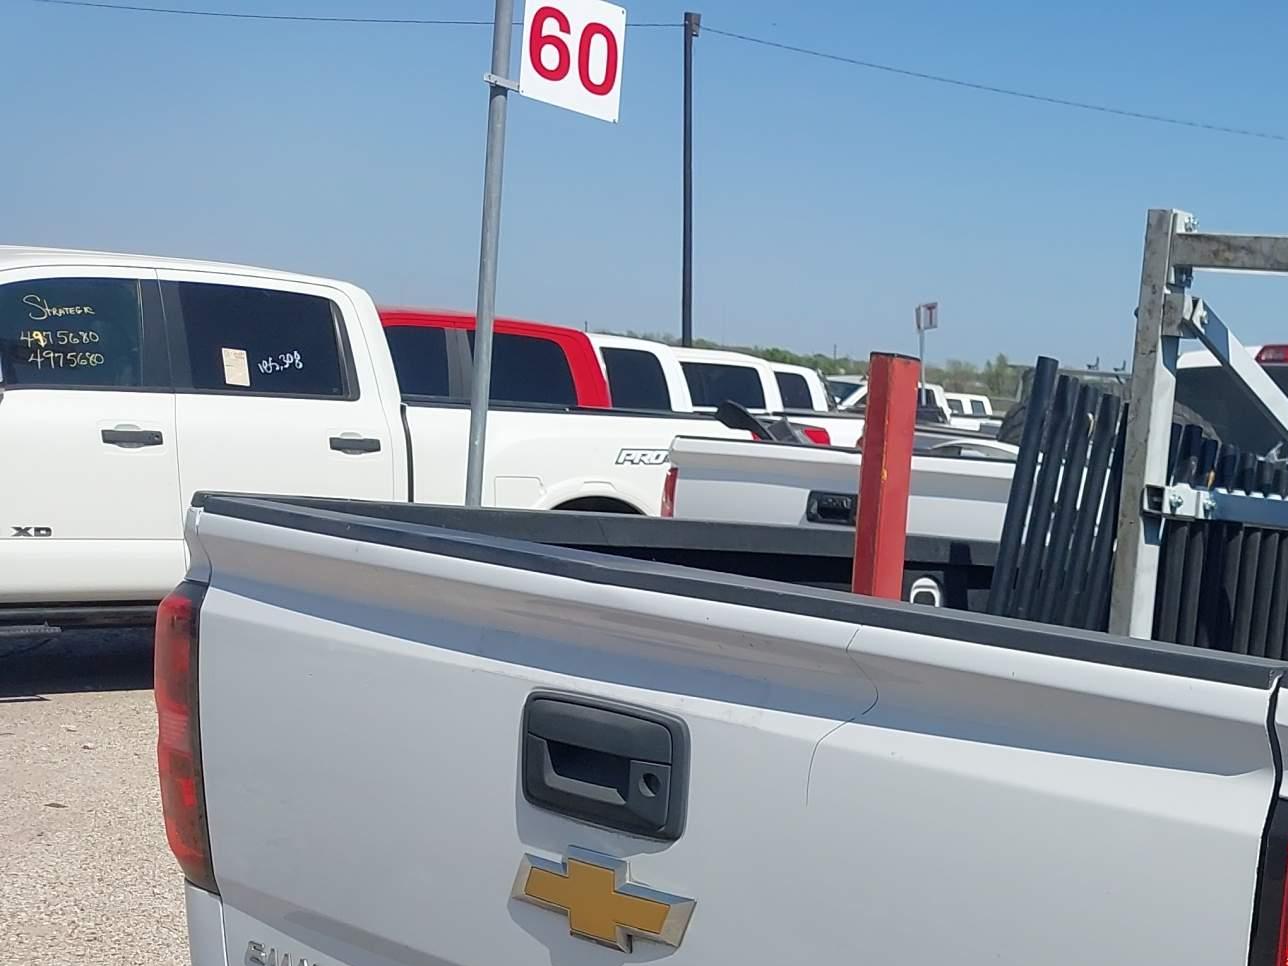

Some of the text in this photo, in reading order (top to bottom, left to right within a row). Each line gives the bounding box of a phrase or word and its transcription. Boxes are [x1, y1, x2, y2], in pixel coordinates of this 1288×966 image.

[528, 6, 618, 96] 60
[28, 349, 105, 369] 4975680
[615, 448, 670, 465] PRO
[10, 526, 53, 538] XD
